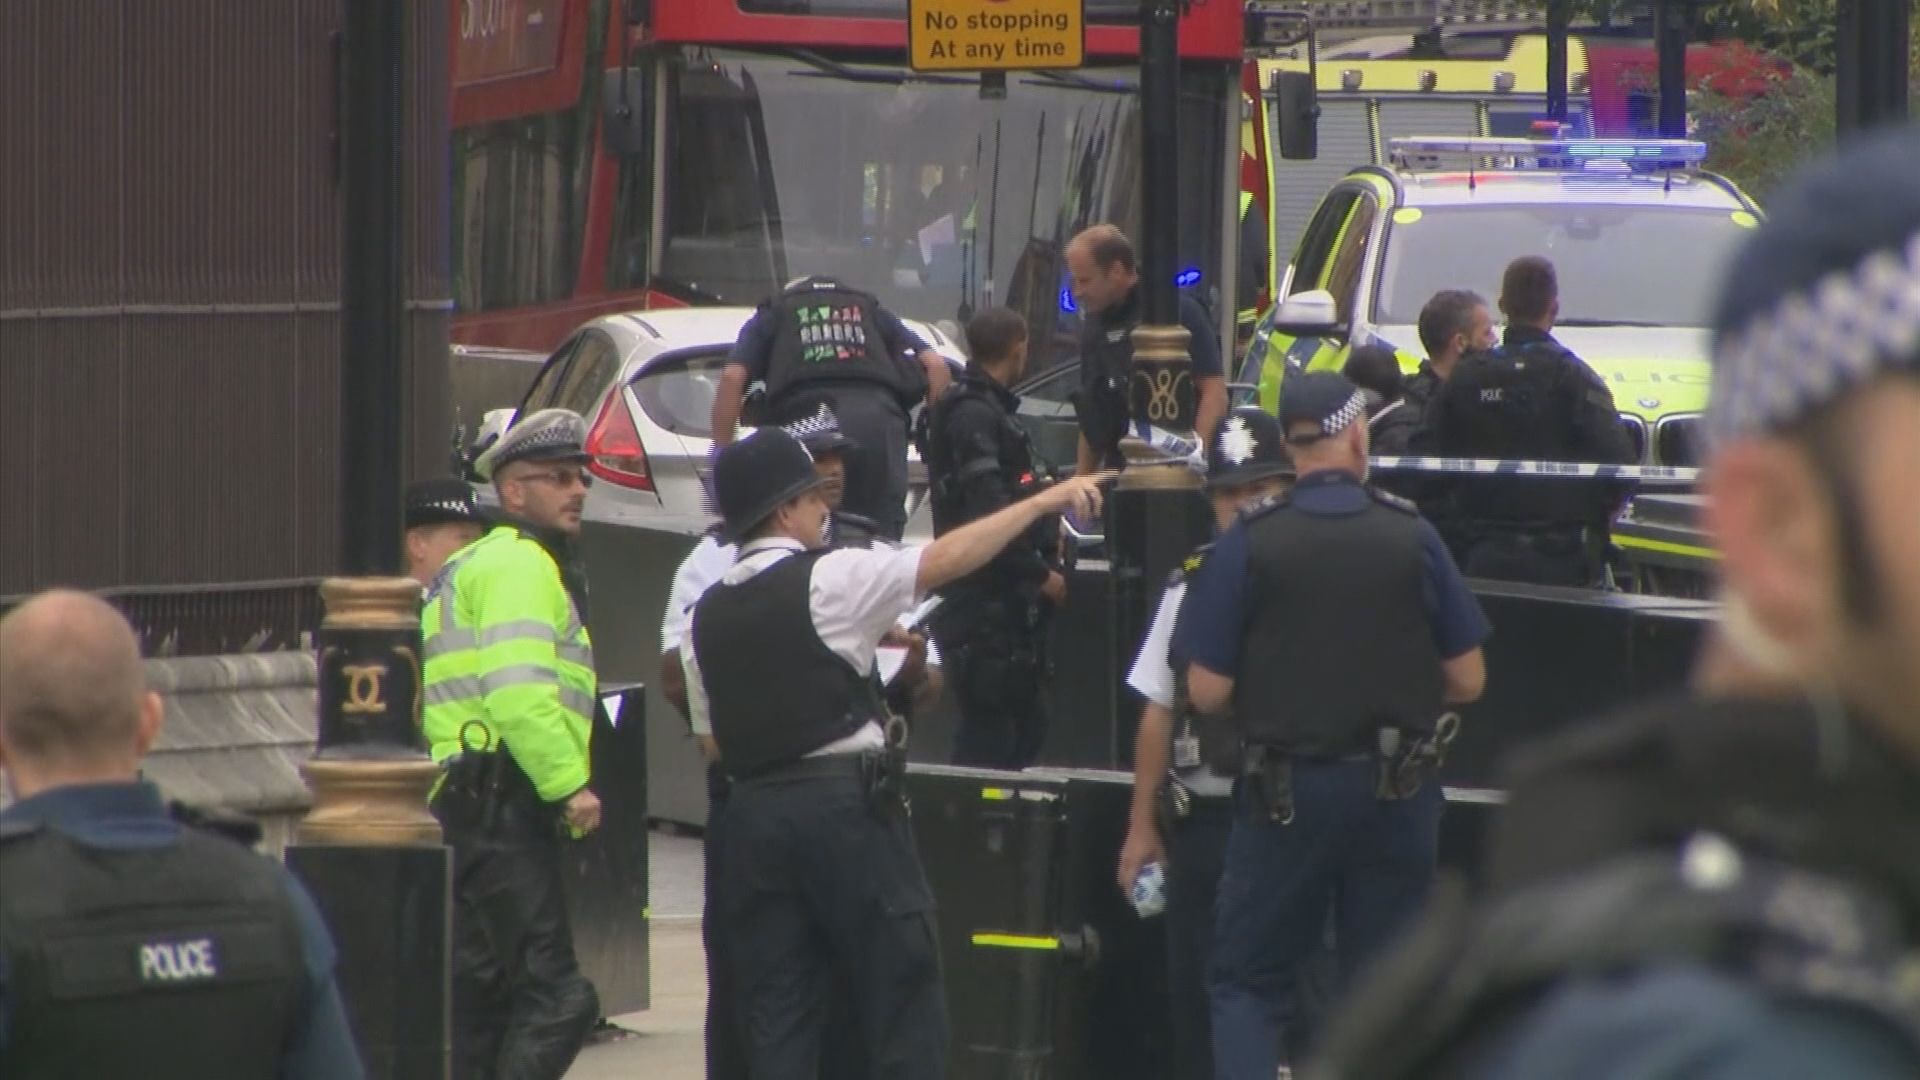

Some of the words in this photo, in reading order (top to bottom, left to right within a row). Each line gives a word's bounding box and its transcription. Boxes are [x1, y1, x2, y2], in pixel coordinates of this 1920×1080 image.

[925, 11, 958, 30] No
[967, 9, 1068, 32] stopping
[930, 39, 956, 59] At
[965, 43, 1005, 61] any
[1015, 38, 1065, 57] time
[141, 939, 217, 979] POLICE
